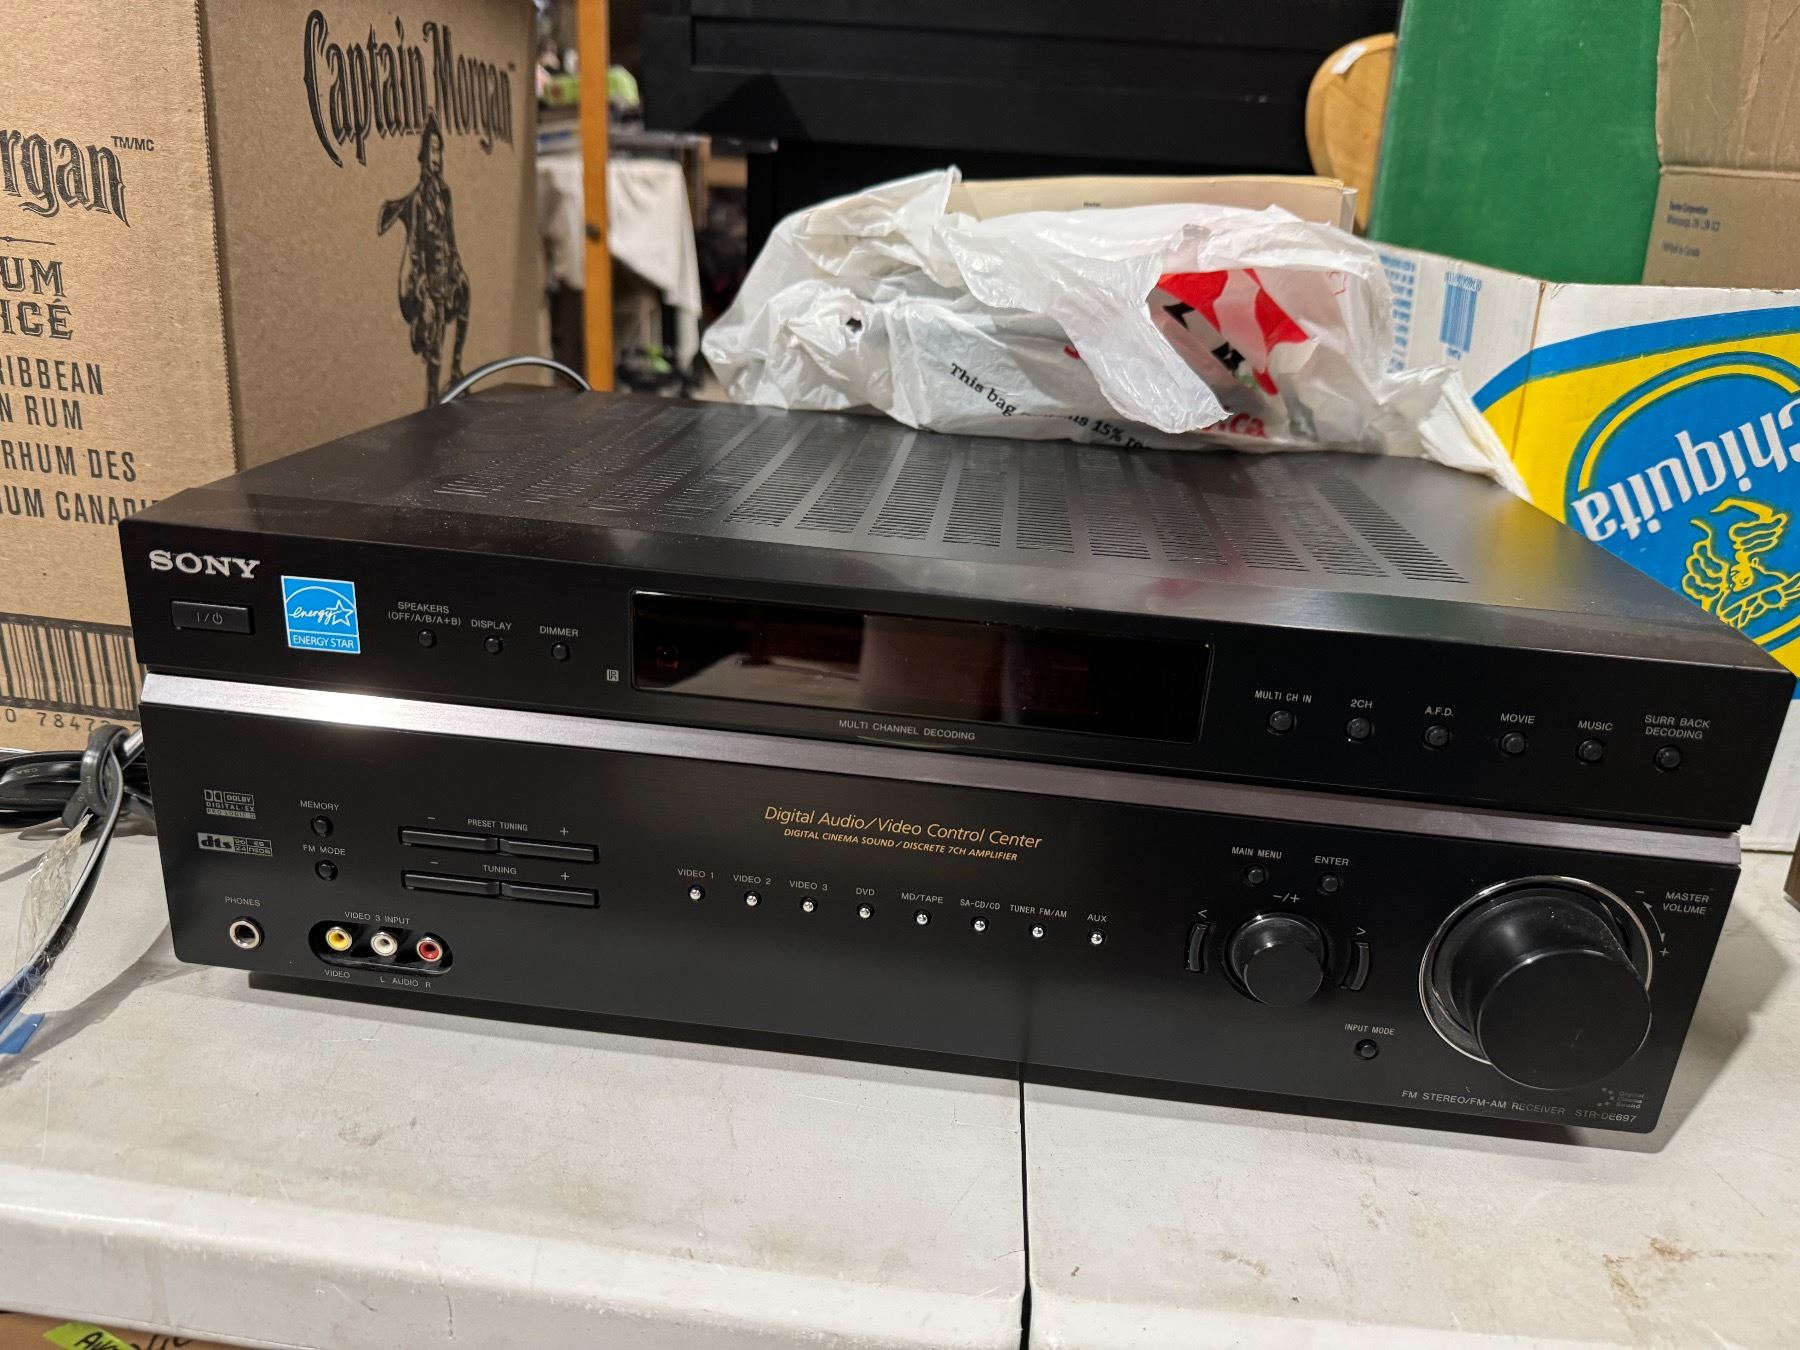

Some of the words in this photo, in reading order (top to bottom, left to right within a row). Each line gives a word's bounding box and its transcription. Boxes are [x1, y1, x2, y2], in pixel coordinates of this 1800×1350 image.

[303, 9, 428, 168] Captain
[422, 20, 514, 156] Morgan
[111, 135, 155, 151] TM/MC
[950, 362, 984, 394] This
[986, 390, 1017, 417] bag
[1091, 420, 1125, 441] 15%
[24, 395, 83, 430] RUM
[1, 439, 77, 476] RHUM
[87, 448, 137, 482] DES
[0, 484, 45, 518] UM
[149, 549, 261, 579] SONY
[398, 601, 450, 614] SPEAKERS
[291, 606, 334, 625] energy
[388, 611, 462, 626] (OFF/A/B/A+B)
[471, 619, 513, 631] DISPLAY
[539, 625, 579, 637] DIMMER
[293, 634, 329, 648] ENERGY
[330, 638, 355, 649] STAR
[1254, 690, 1282, 701] MULTI
[1286, 693, 1298, 702] CH
[1303, 694, 1312, 703] IN
[1350, 699, 1373, 709] 2CH
[5, 708, 17, 723] 0
[1500, 712, 1536, 725] MOVIE
[1644, 714, 1675, 726] SURR
[1679, 717, 1711, 729] BACK
[838, 719, 869, 731] MULTI
[872, 721, 919, 736] CHANNEL
[923, 727, 976, 741] DECODING
[1577, 720, 1614, 732] MUSIC
[1645, 726, 1703, 740] DECODING
[300, 800, 340, 812] MEMORY
[467, 818, 496, 829] PRESET
[499, 821, 529, 832] TUNING
[764, 806, 815, 825] Digital
[817, 812, 922, 836] Audio/Video
[927, 824, 985, 843] Control
[989, 831, 1043, 849] Center
[201, 835, 233, 849] dts
[784, 828, 820, 840] DIGITAL
[822, 832, 859, 844] CINEMA
[948, 846, 966, 855] 7CH
[968, 848, 1018, 861] AMPLIFIER
[303, 844, 316, 853] FM
[319, 846, 346, 856] MODE
[1231, 846, 1254, 857] MAIN
[1257, 849, 1283, 860] MENU
[1314, 855, 1350, 867] ENTER
[482, 864, 517, 875] TUNING
[677, 868, 706, 878] VIDEO
[733, 874, 762, 884] VIDEO
[789, 880, 818, 890] VIDEO
[855, 887, 875, 896] DVD
[901, 892, 944, 904] MD/TAPE
[1665, 891, 1710, 903] MASTER
[224, 896, 261, 907] PHONES
[959, 899, 1001, 910] SA-CD/CD
[1010, 904, 1035, 915] TUNER
[1039, 907, 1067, 918] FM/AM
[1662, 903, 1708, 915] VOLUME
[344, 911, 371, 921] VIDEO
[384, 915, 411, 925] INPUT
[1087, 913, 1107, 923] AUX
[324, 969, 351, 979] VIDEO
[392, 977, 419, 987] AUDIO
[1344, 1023, 1368, 1033] INPUT
[1371, 1026, 1396, 1036] MODE
[1402, 1089, 1418, 1100] FM
[1422, 1092, 1507, 1109] STEREO/FM-AM
[1511, 1101, 1566, 1115] RECEIVER
[1575, 1109, 1637, 1124] STR-DE697
